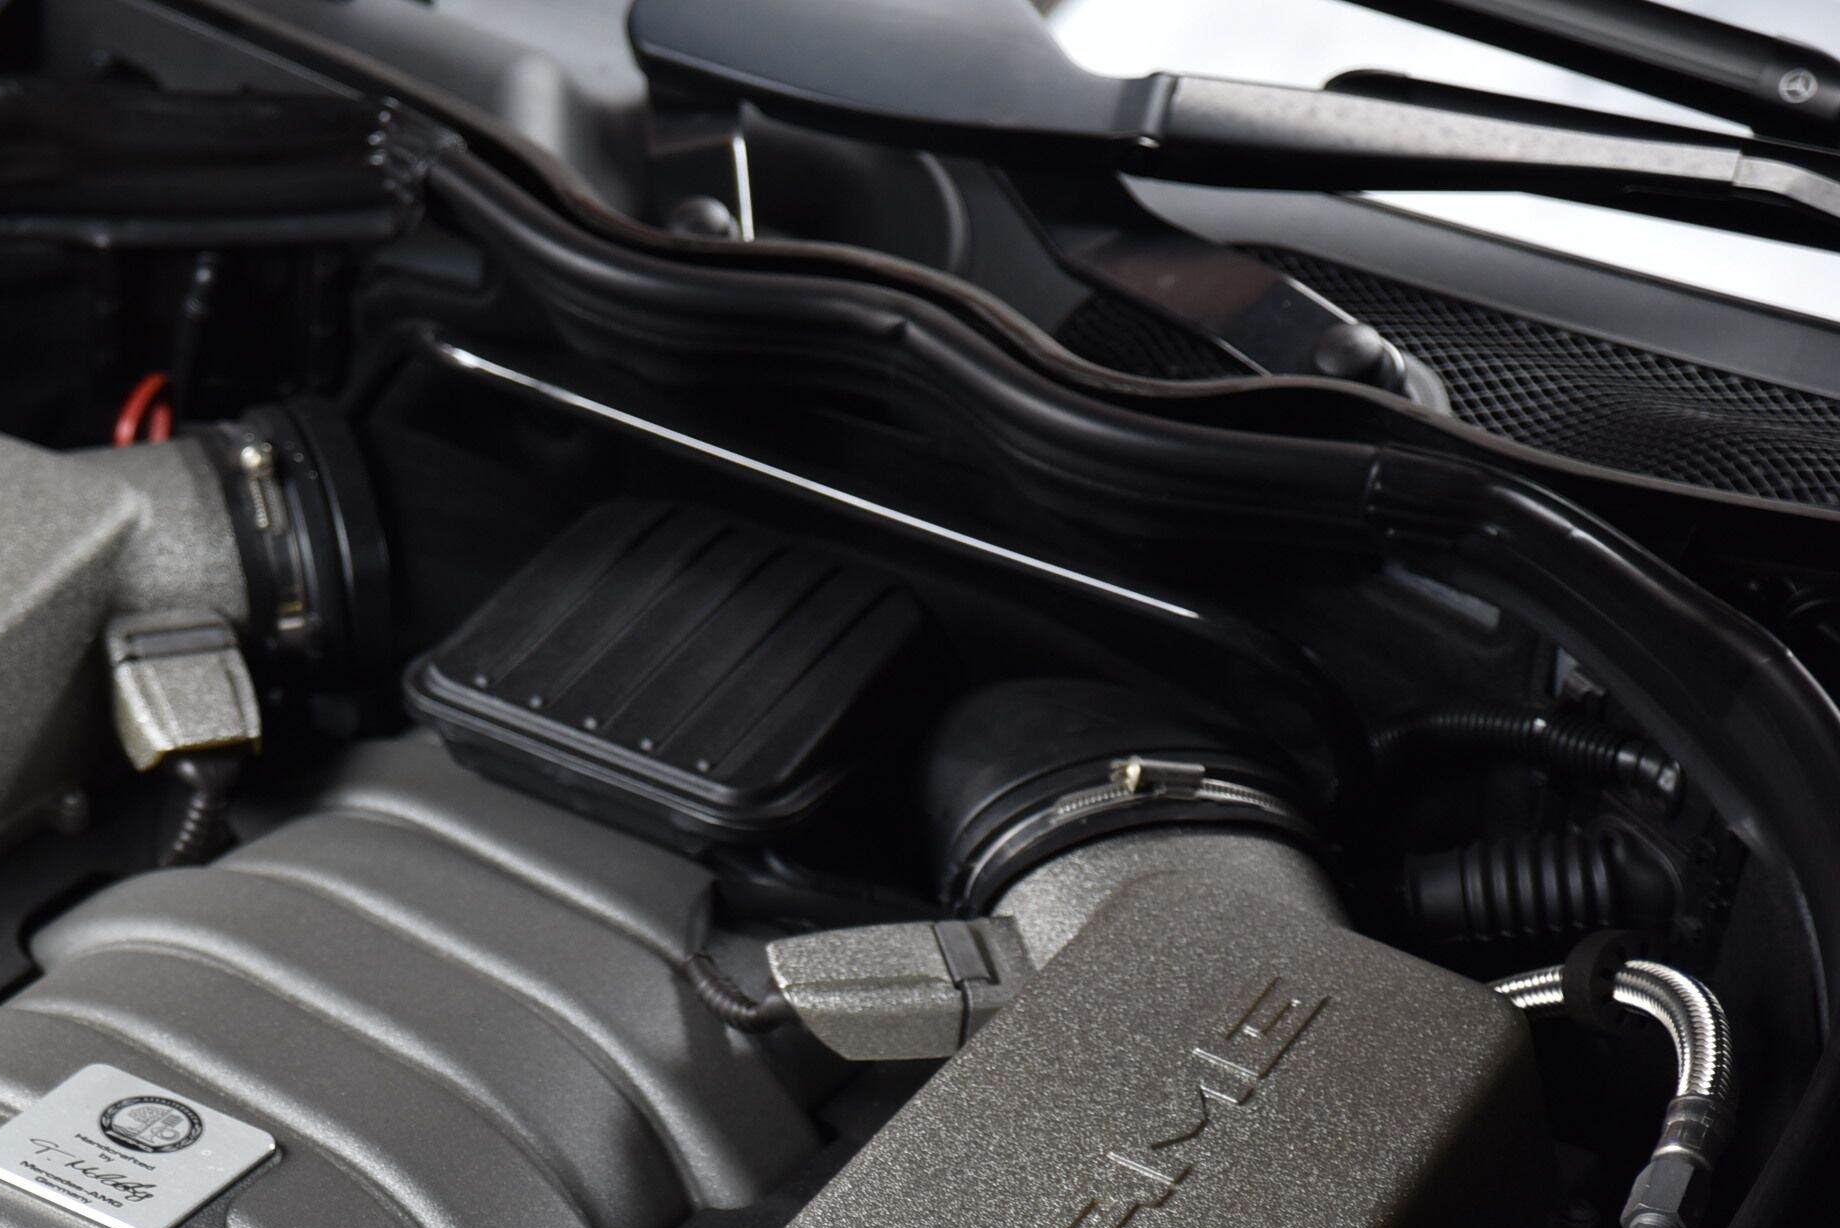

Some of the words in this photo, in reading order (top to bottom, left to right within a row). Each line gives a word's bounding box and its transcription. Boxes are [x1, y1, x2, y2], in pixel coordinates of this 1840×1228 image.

[74, 1132, 156, 1171] Handcrafted
[99, 1153, 115, 1162] by
[19, 1160, 124, 1208] Mercedes-AMG
[34, 1176, 92, 1204] Germany
